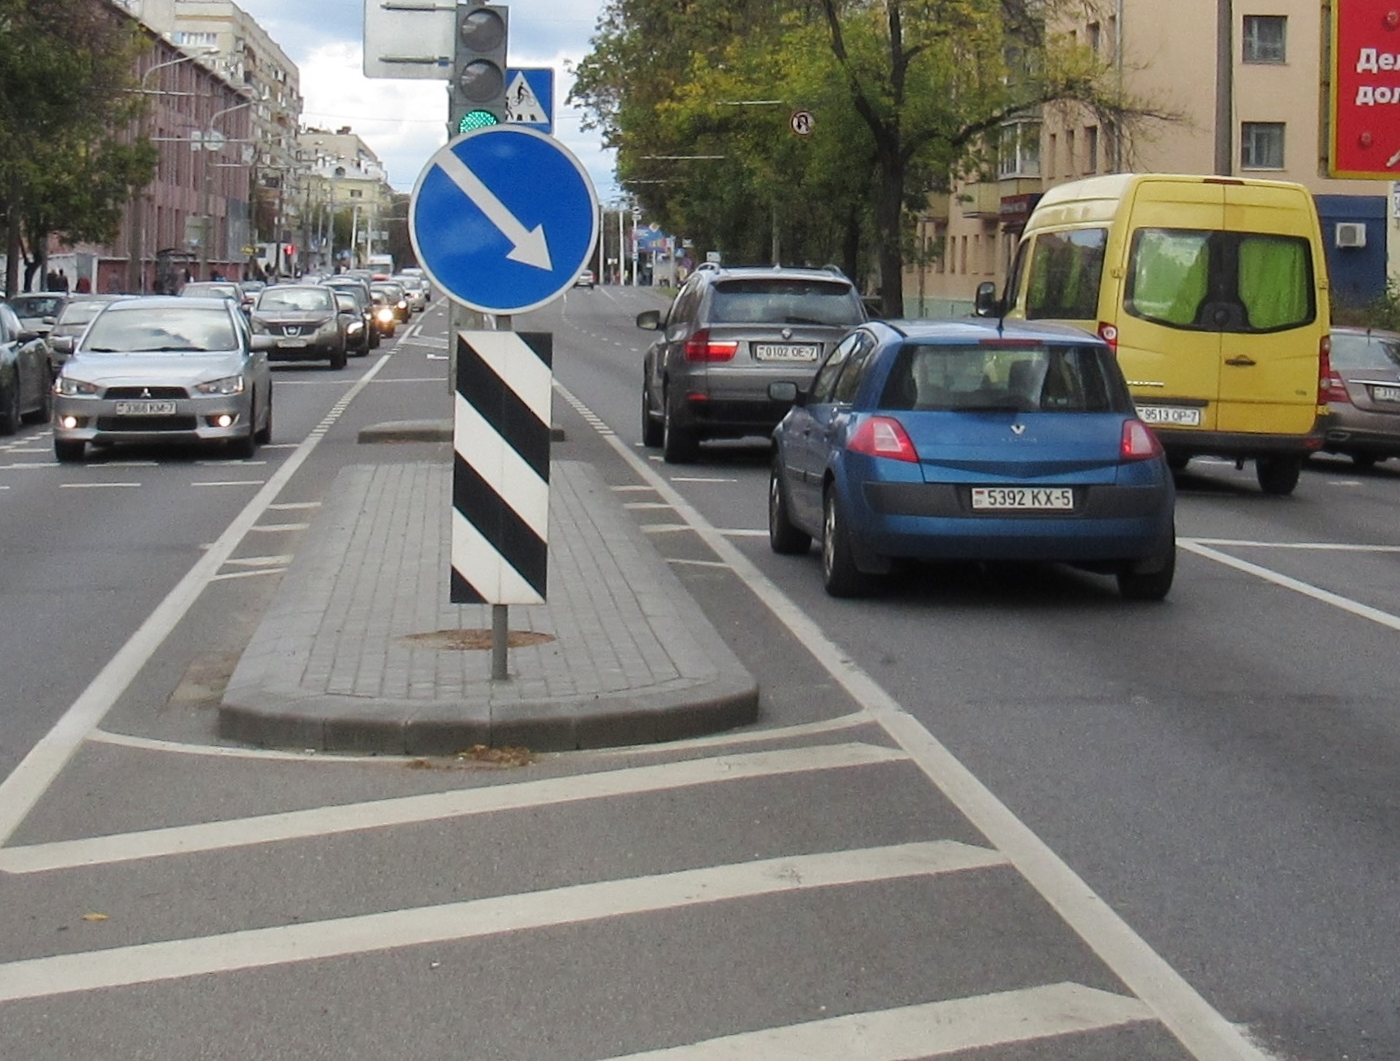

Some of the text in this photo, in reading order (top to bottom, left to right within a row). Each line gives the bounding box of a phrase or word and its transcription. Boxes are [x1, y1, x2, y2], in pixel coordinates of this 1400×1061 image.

[765, 346, 815, 357] 0102 OE-7
[1145, 407, 1198, 423] 9513 OP-7
[987, 489, 1071, 507] 5392 KX-5
